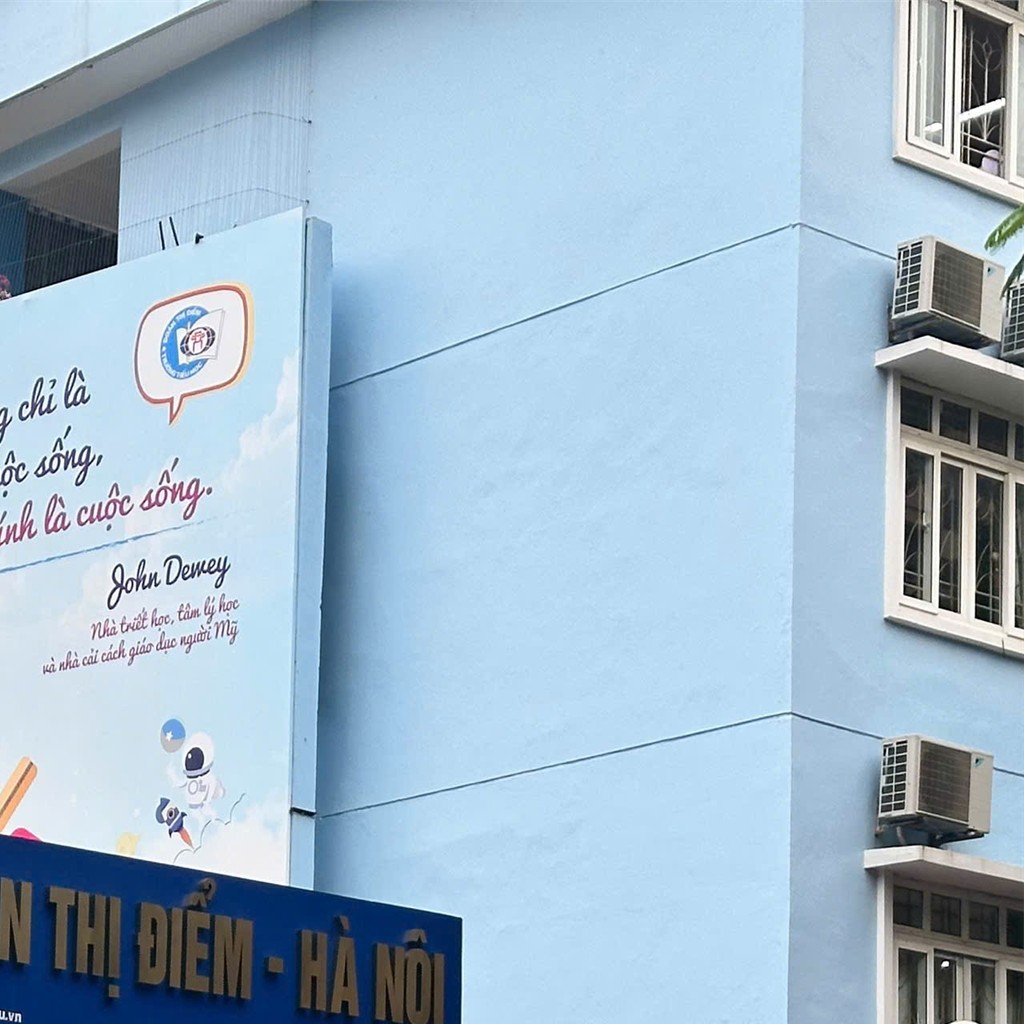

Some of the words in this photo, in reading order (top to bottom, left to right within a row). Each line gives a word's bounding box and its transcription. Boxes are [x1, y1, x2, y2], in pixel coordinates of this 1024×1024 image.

[18, 376, 57, 421] chỉ
[64, 367, 91, 409] là
[34, 425, 103, 487] sống,
[44, 493, 71, 541] là
[77, 482, 134, 531] cuộc
[139, 457, 213, 521] sống.
[107, 558, 161, 610] John
[163, 554, 231, 589] Dewey
[91, 618, 118, 640] Nhà
[119, 606, 148, 633] triết
[151, 608, 175, 631] học,
[177, 602, 201, 621] tâm
[203, 596, 216, 624] lý
[218, 593, 240, 617] học
[42, 656, 57, 675] và
[59, 651, 80, 671] nhà
[82, 648, 99, 666] cải
[101, 640, 127, 662] cách
[128, 637, 154, 666] giáo
[156, 631, 177, 655] dục
[180, 625, 212, 654] người
[214, 619, 239, 645] Mỹ
[46, 885, 121, 999] THỊ
[135, 877, 254, 1001] ĐIỂM
[295, 915, 359, 1017] HÀ
